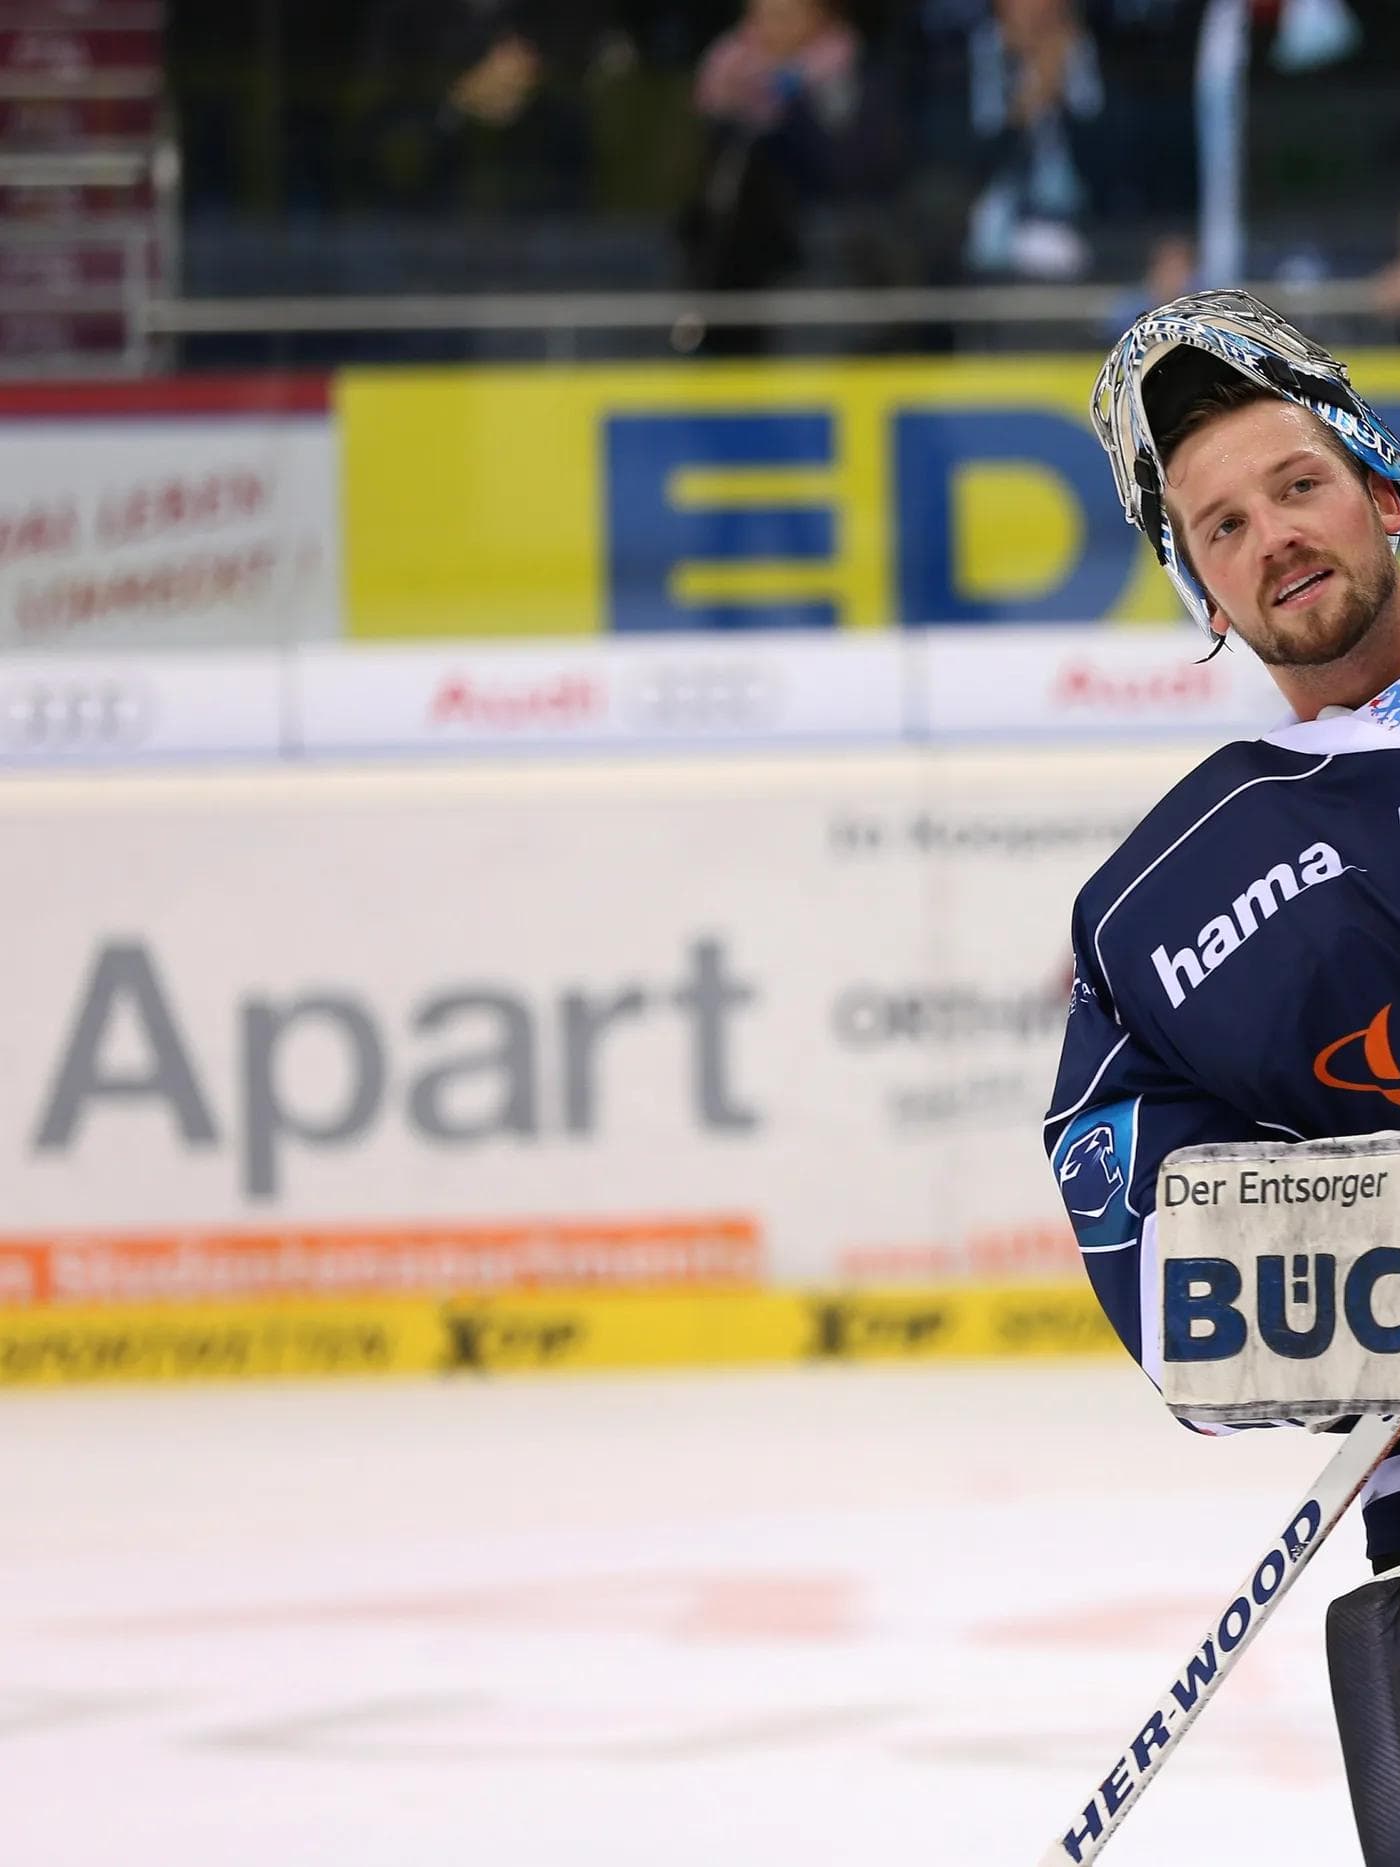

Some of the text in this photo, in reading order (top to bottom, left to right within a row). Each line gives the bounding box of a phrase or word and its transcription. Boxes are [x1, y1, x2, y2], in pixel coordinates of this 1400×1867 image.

[432, 680, 602, 724] Audi
[1056, 660, 1224, 706] Audi
[1150, 842, 1344, 1010] hama
[33, 938, 758, 1200] Apart
[1164, 1170, 1388, 1208] Der Entsorger
[1062, 1498, 1321, 1864] HER-WOOD
